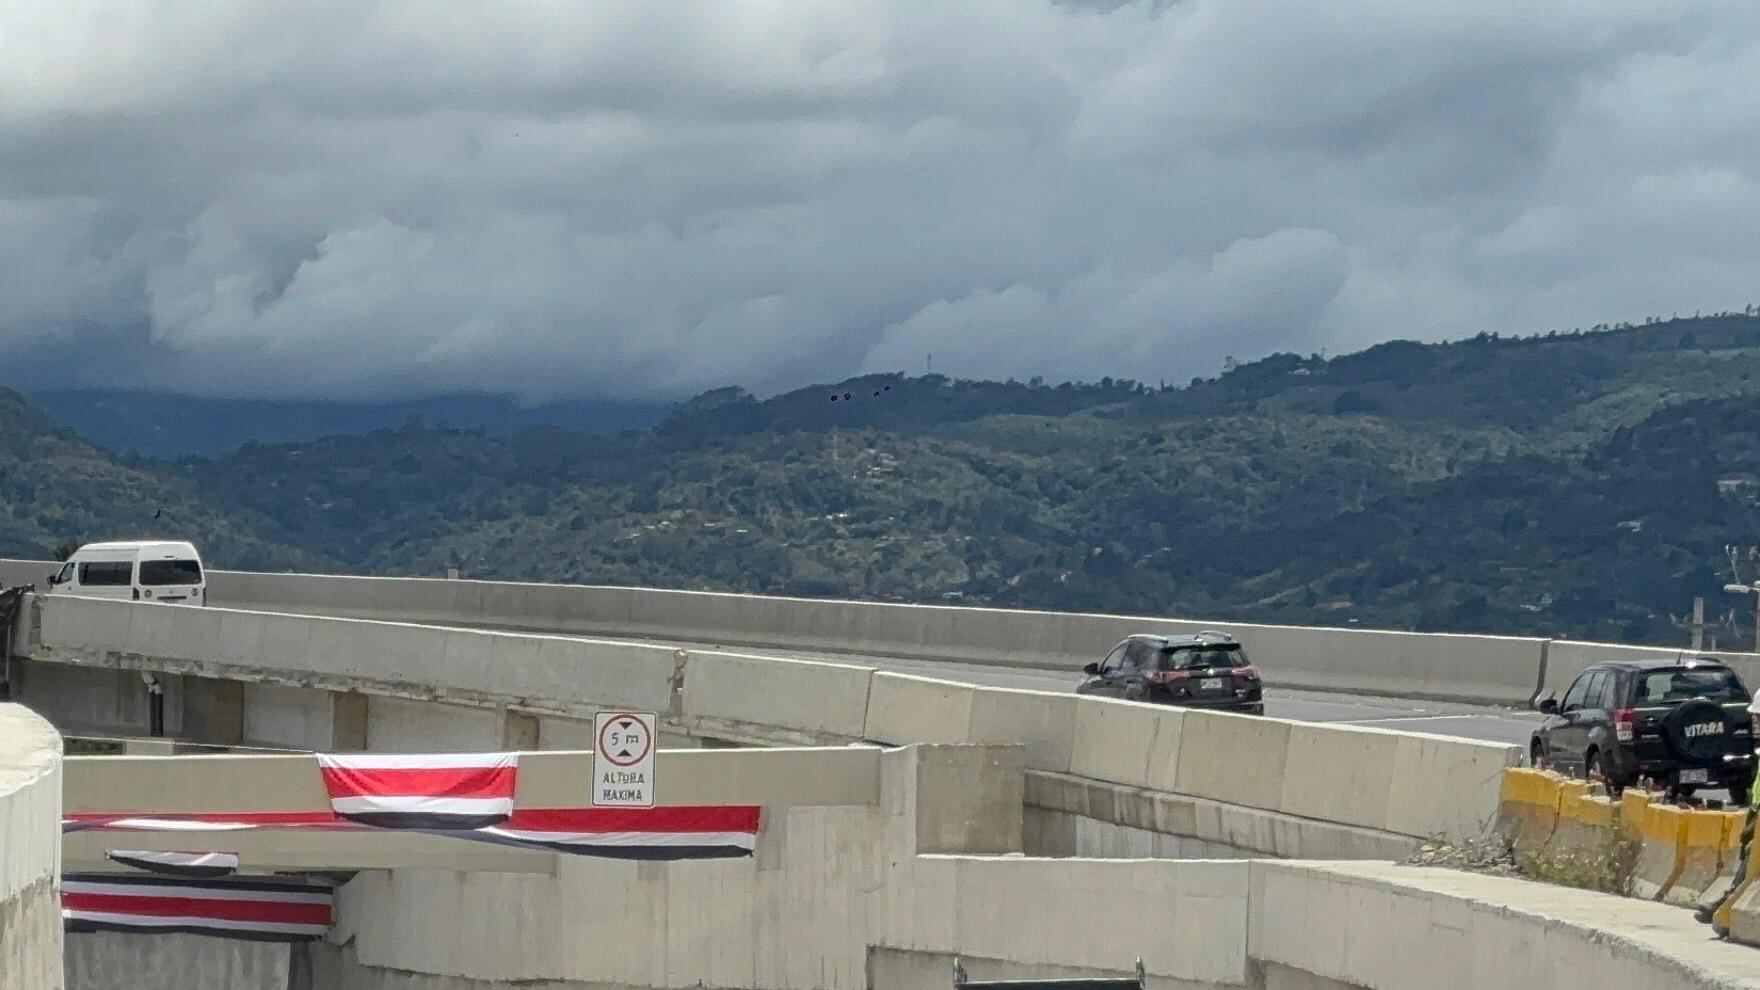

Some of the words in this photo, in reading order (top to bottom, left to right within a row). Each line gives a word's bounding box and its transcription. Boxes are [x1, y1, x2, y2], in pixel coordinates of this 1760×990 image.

[1684, 721, 1723, 738] VITARA
[611, 732, 619, 746] 5
[625, 734, 639, 744] m
[602, 772, 645, 784] ALTURA
[603, 789, 643, 801] MAXIMA
